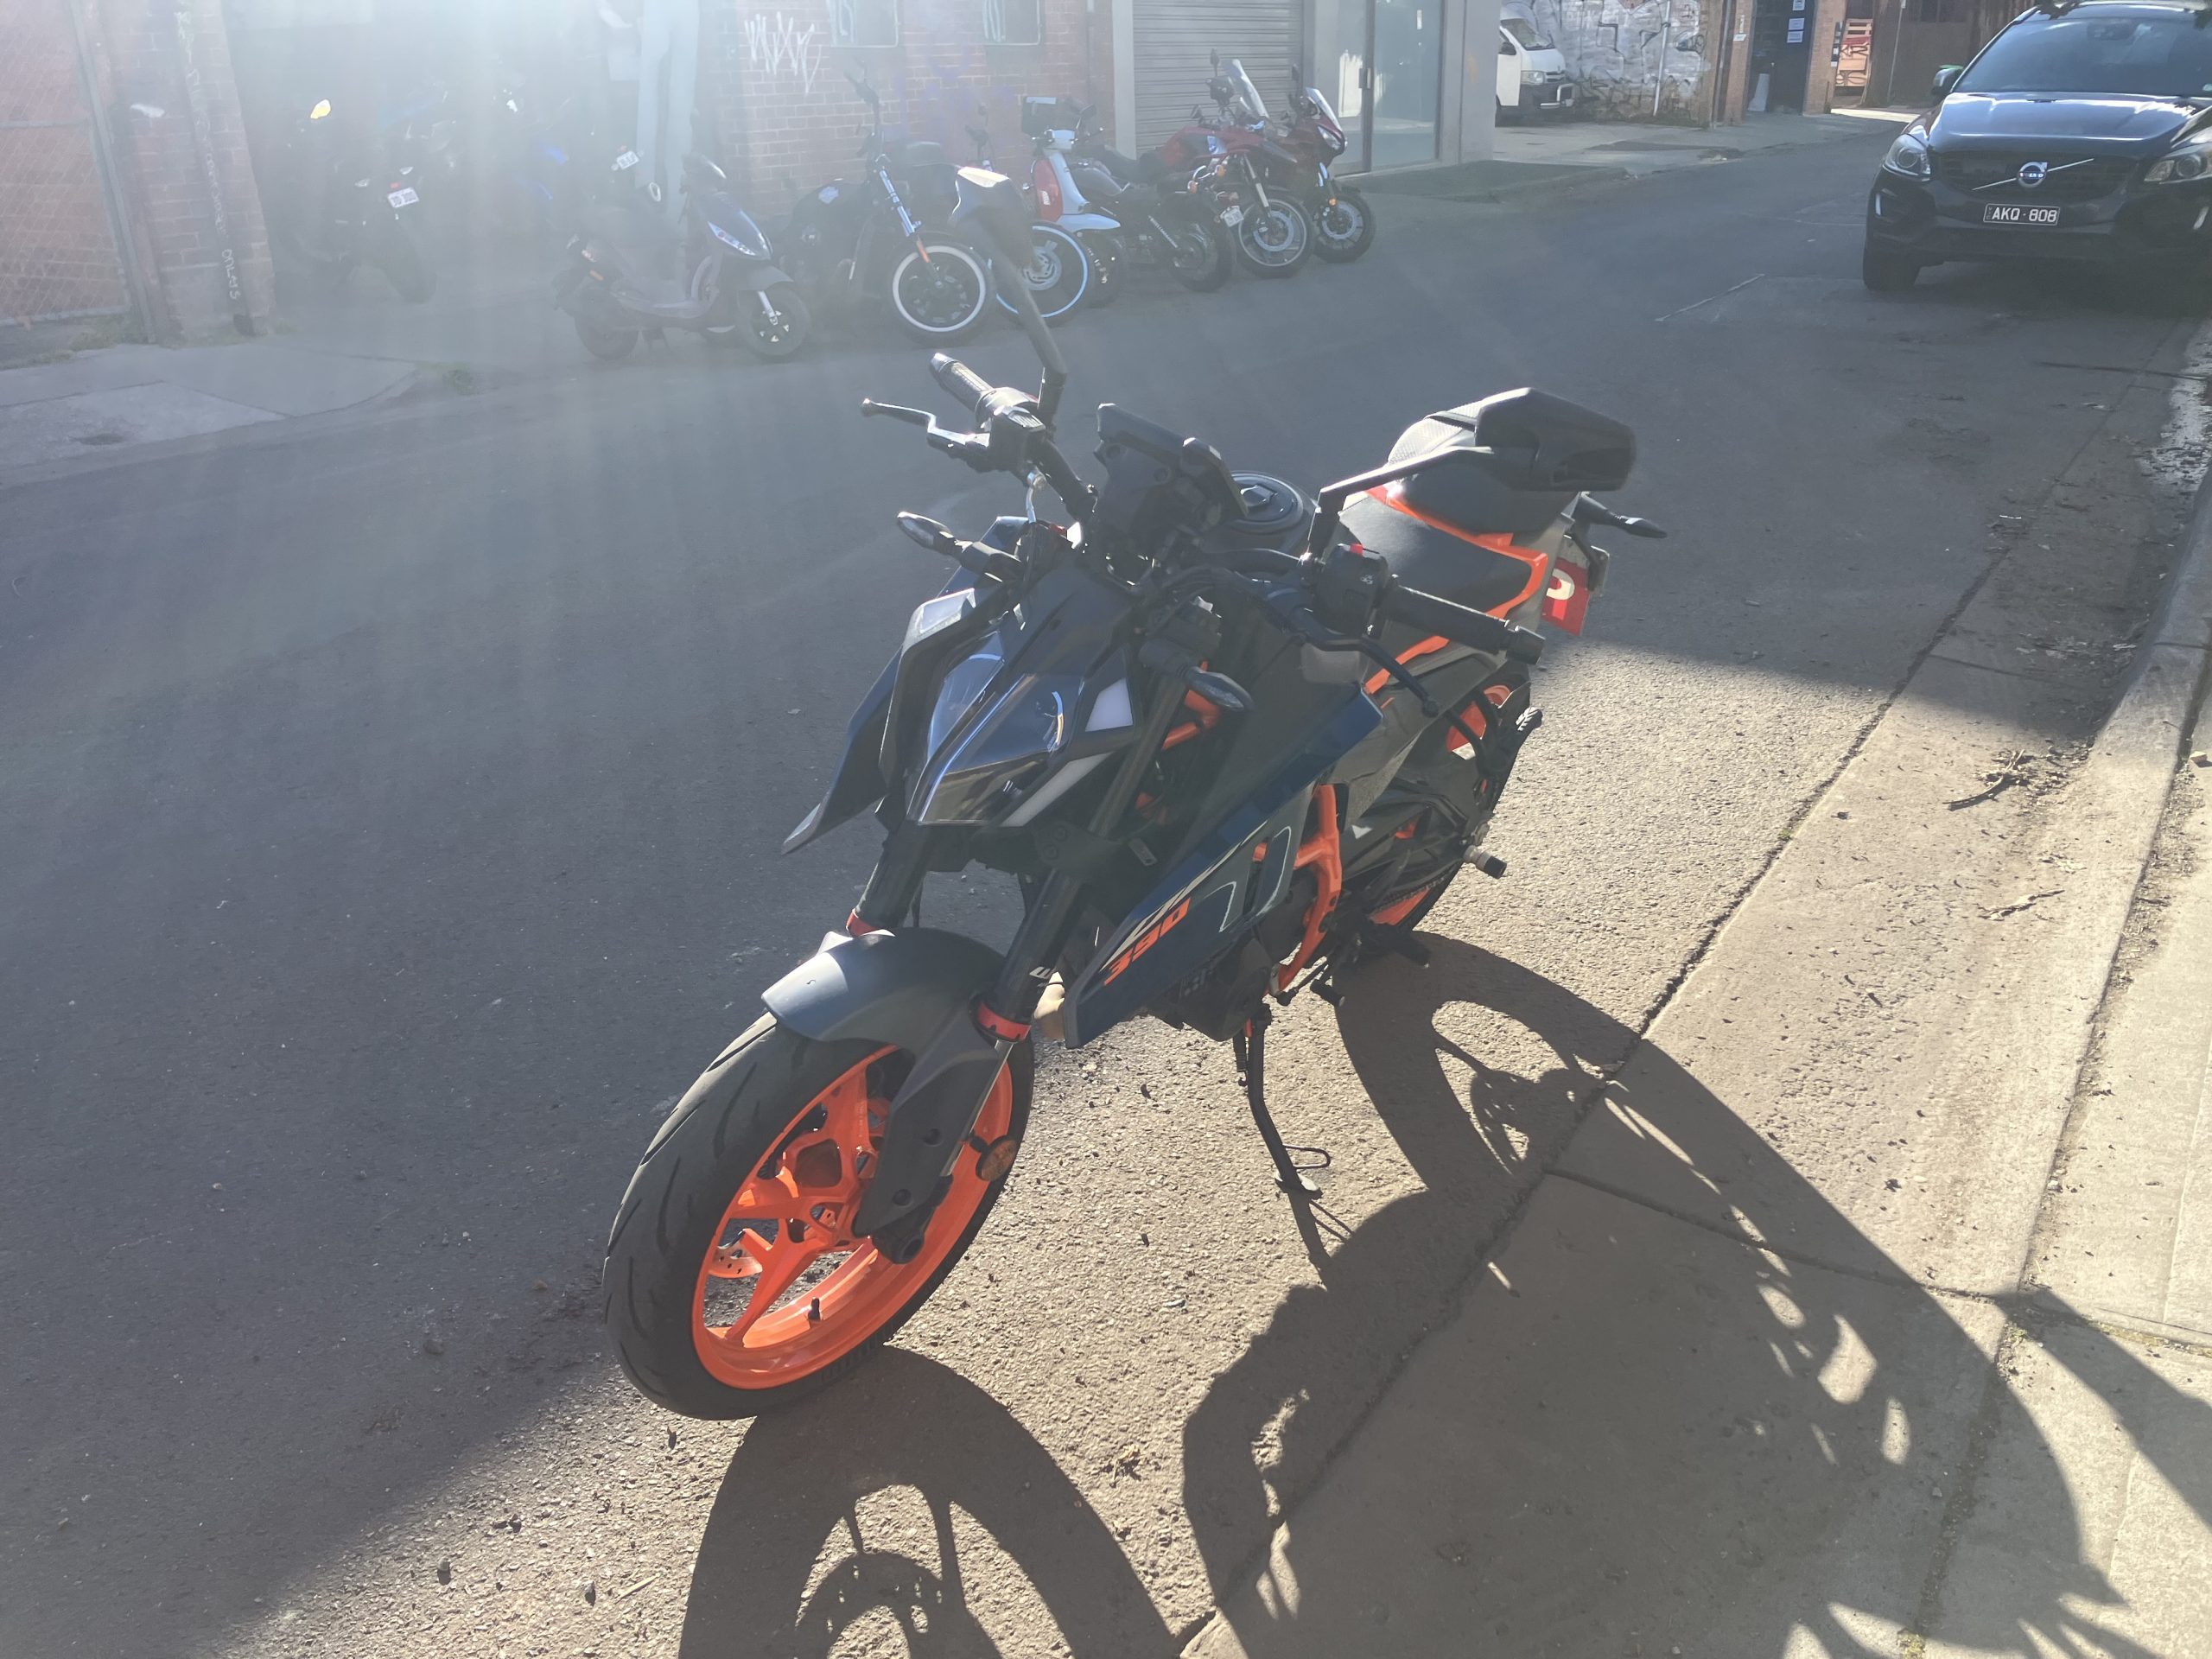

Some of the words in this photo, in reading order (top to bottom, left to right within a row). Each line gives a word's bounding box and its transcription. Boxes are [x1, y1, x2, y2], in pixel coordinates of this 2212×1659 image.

[1992, 207, 2020, 220] AKQ
[2028, 208, 2057, 222] 808
[1103, 897, 1192, 986] 390
